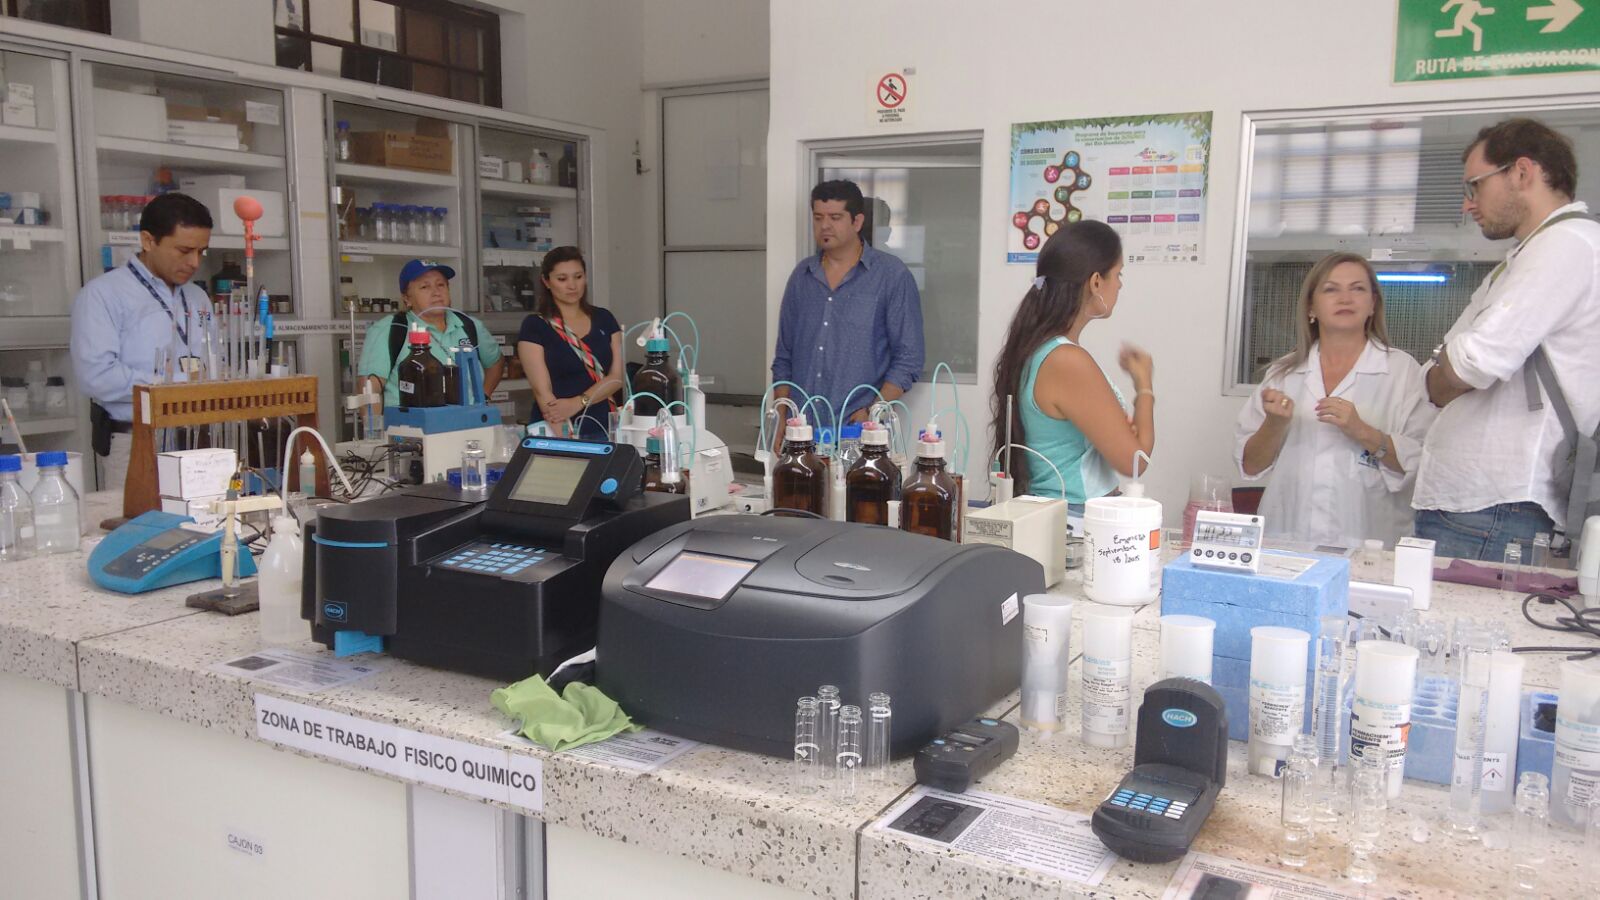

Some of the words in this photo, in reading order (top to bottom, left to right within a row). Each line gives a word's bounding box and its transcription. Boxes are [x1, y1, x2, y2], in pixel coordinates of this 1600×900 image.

[1415, 58, 1458, 75] RUTA
[1462, 56, 1486, 72] DE
[1490, 47, 1600, 71] EVACUACION
[1166, 713, 1192, 722] HACH
[261, 709, 301, 733] ZONA
[303, 720, 323, 740] DE
[326, 726, 398, 759] TRABAJO
[404, 746, 458, 773] FISICO
[462, 760, 537, 793] QUIMICO
